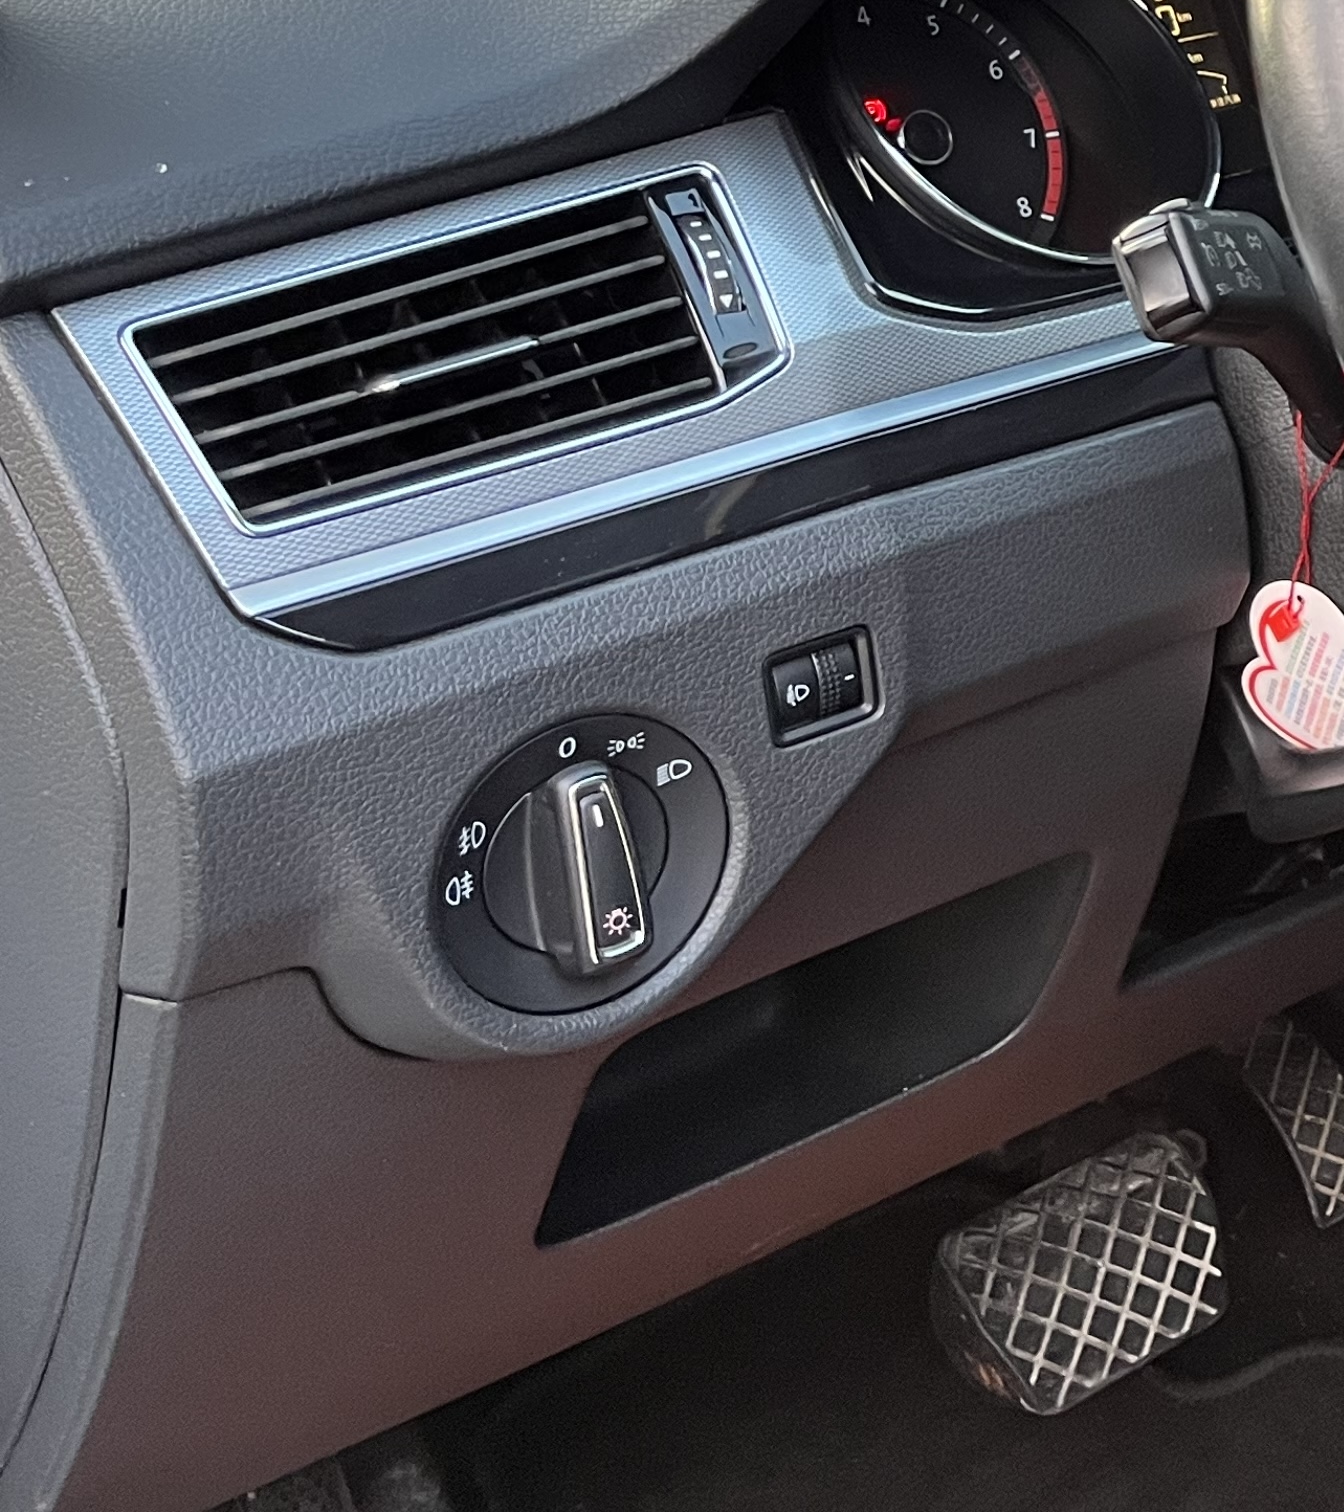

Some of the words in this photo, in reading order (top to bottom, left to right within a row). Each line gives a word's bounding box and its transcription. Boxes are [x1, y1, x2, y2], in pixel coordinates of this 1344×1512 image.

[857, 5, 872, 26] 4
[926, 15, 940, 36] 5
[989, 59, 1004, 80] 6
[1023, 127, 1036, 149] 7
[1016, 196, 1033, 218] 8
